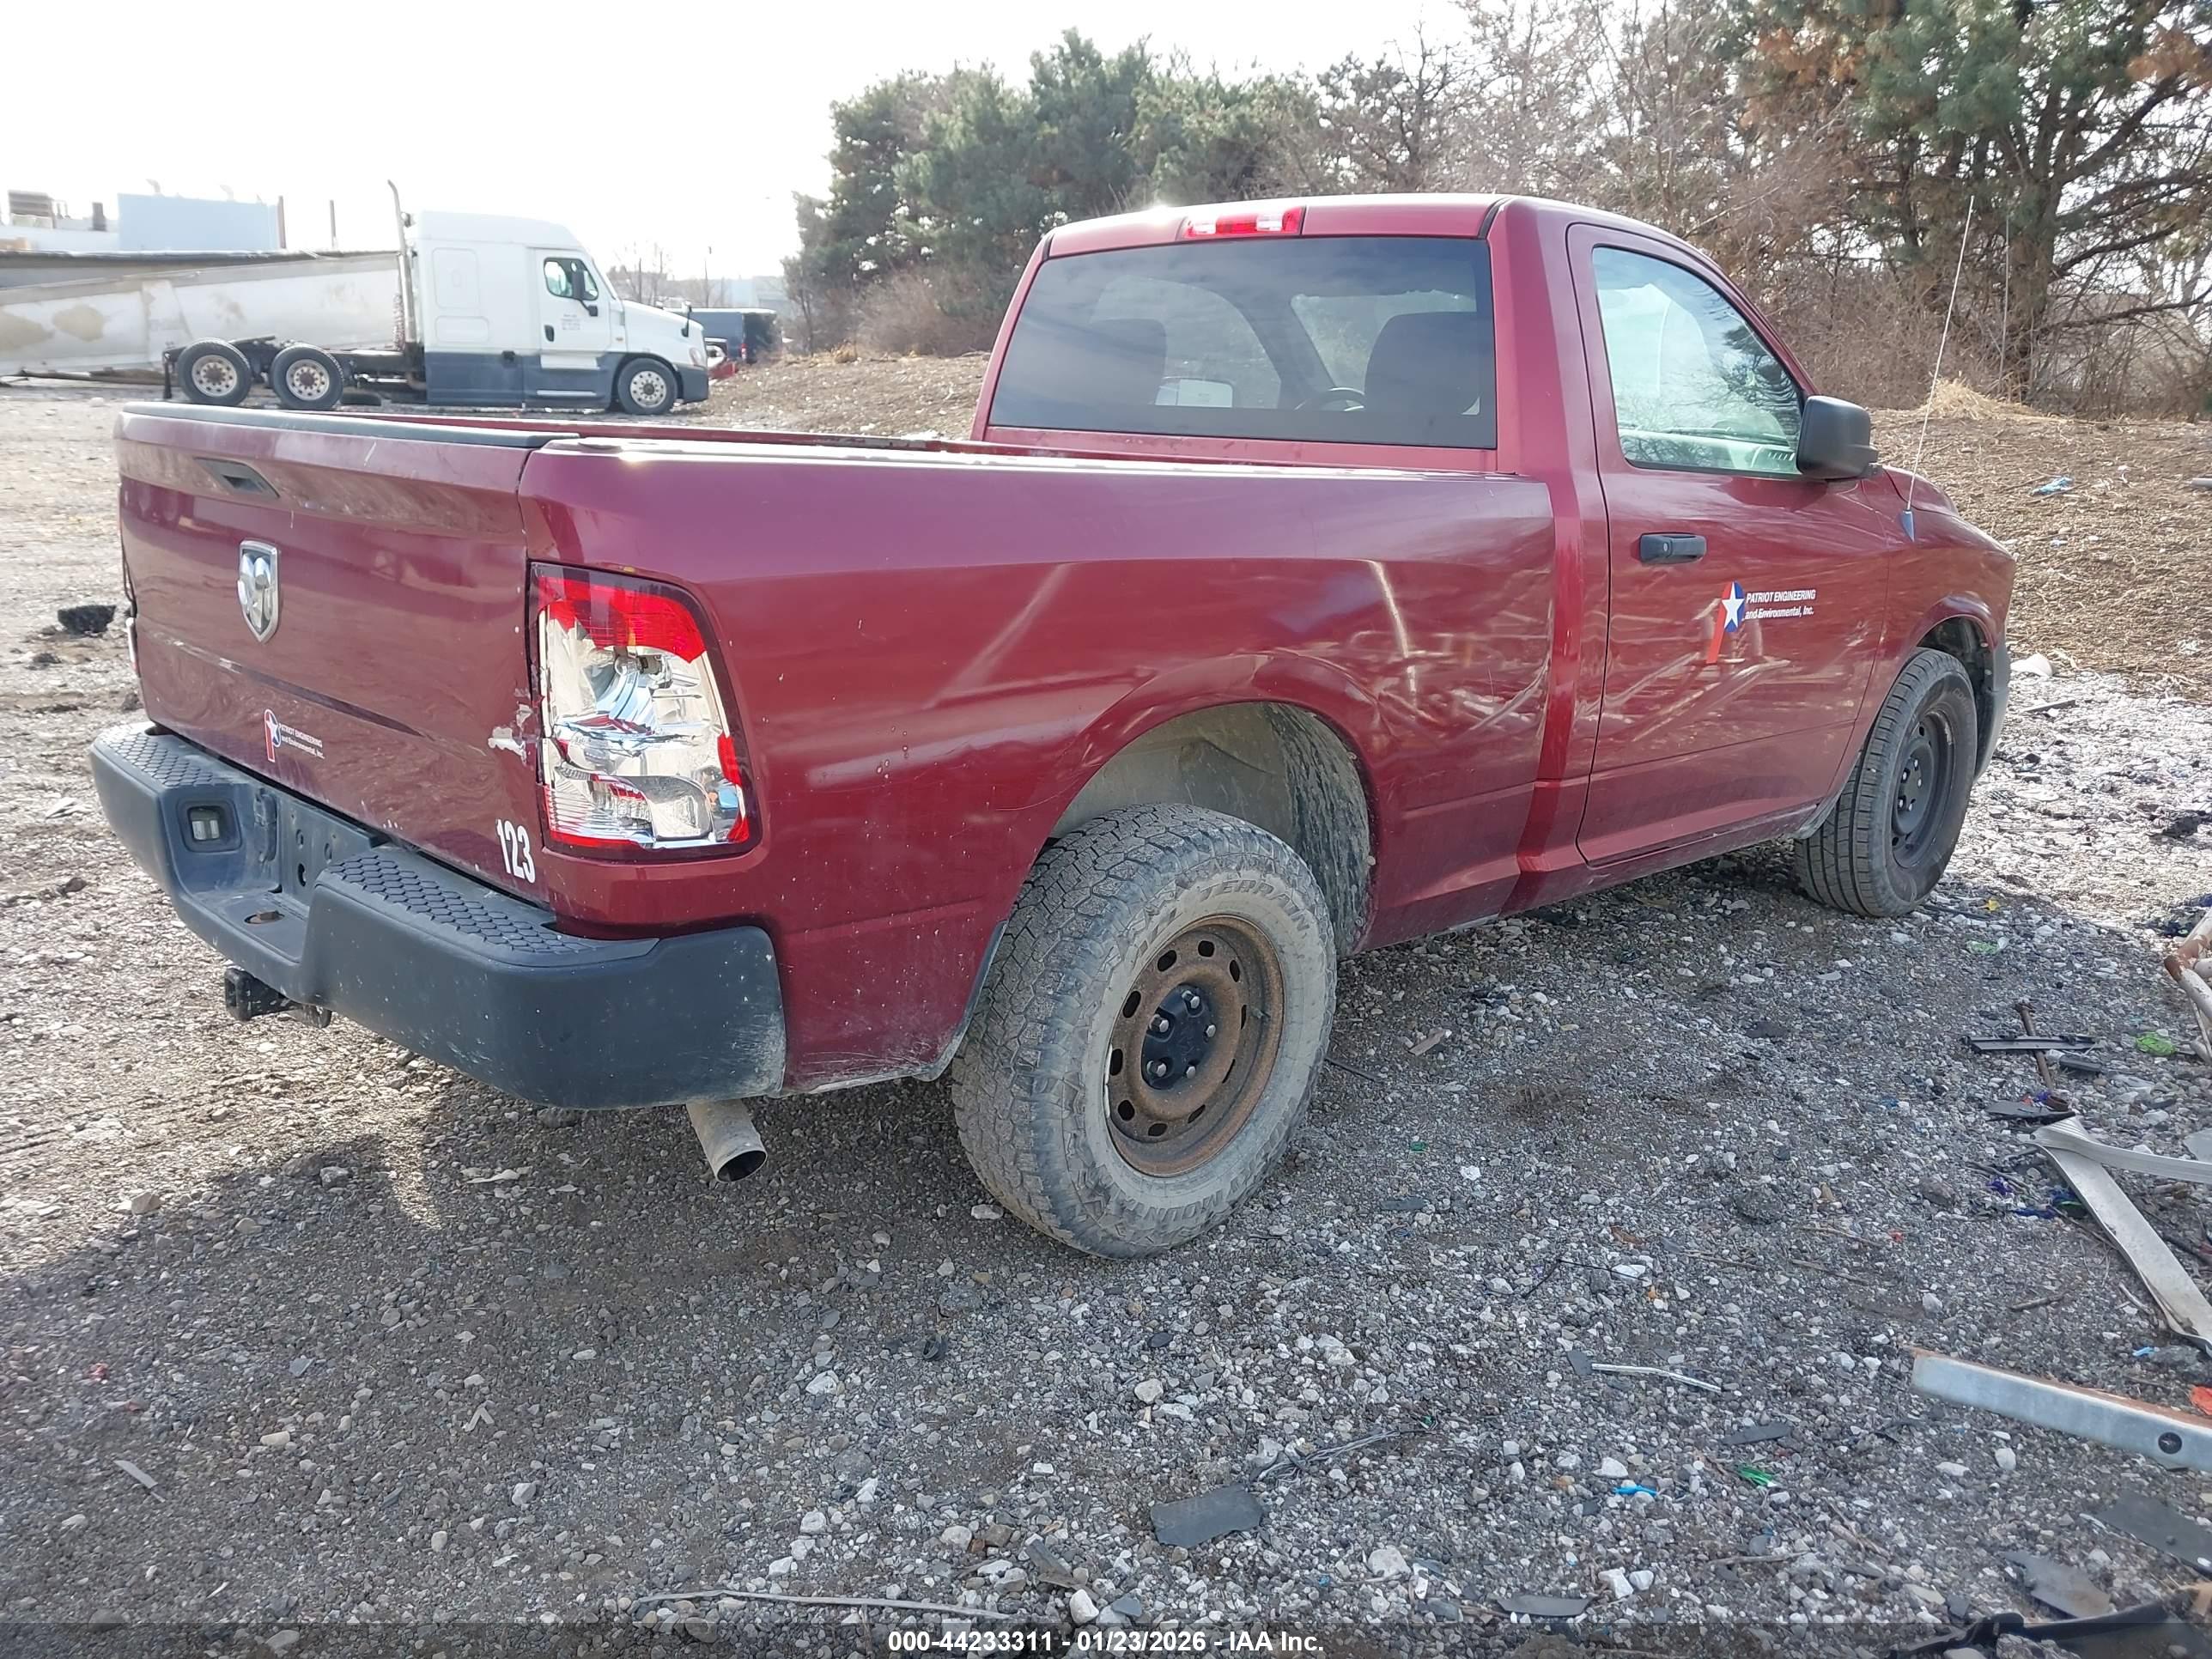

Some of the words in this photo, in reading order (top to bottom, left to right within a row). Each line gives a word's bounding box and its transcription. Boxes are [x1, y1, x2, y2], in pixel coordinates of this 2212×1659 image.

[1746, 591, 1774, 604] PATRIOT
[1773, 588, 1817, 602] ENGINEERING
[1744, 608, 1758, 619] and
[1802, 605, 1814, 616] Inc.
[496, 818, 536, 884] 123
